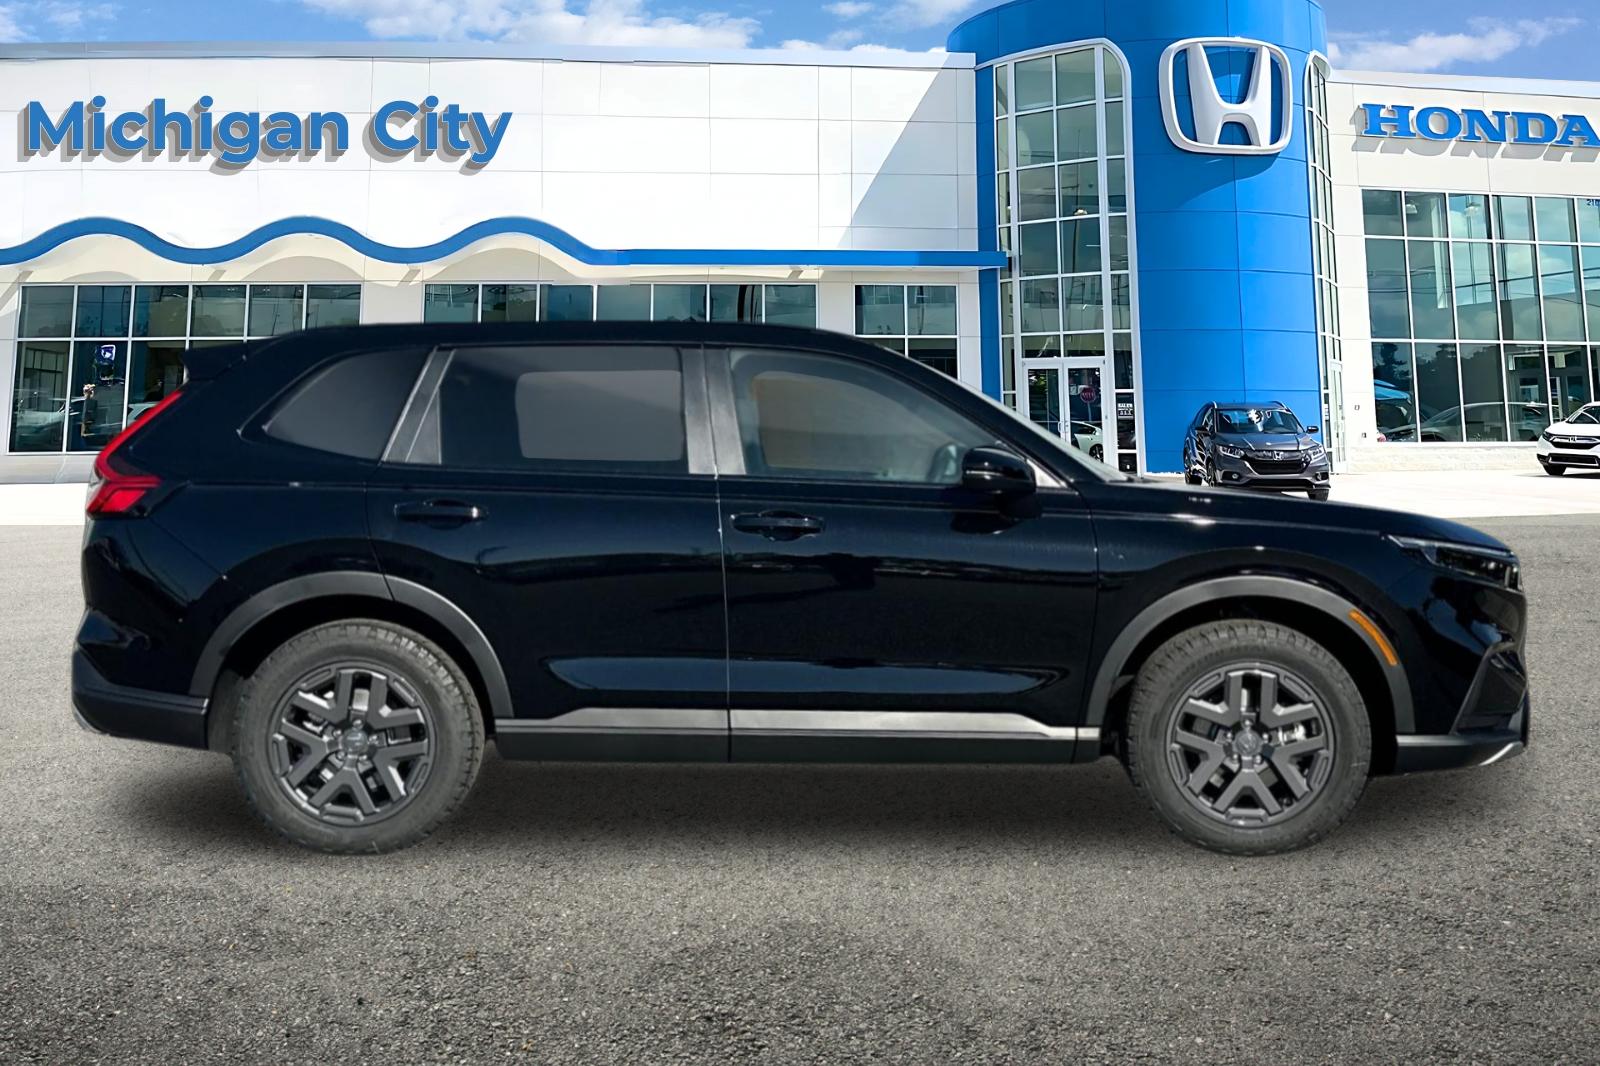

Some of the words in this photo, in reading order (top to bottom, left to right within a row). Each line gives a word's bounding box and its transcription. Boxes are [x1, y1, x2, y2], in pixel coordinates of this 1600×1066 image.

[28, 95, 349, 166] Michigan
[373, 95, 513, 166] City
[1361, 103, 1600, 148] HONDA
